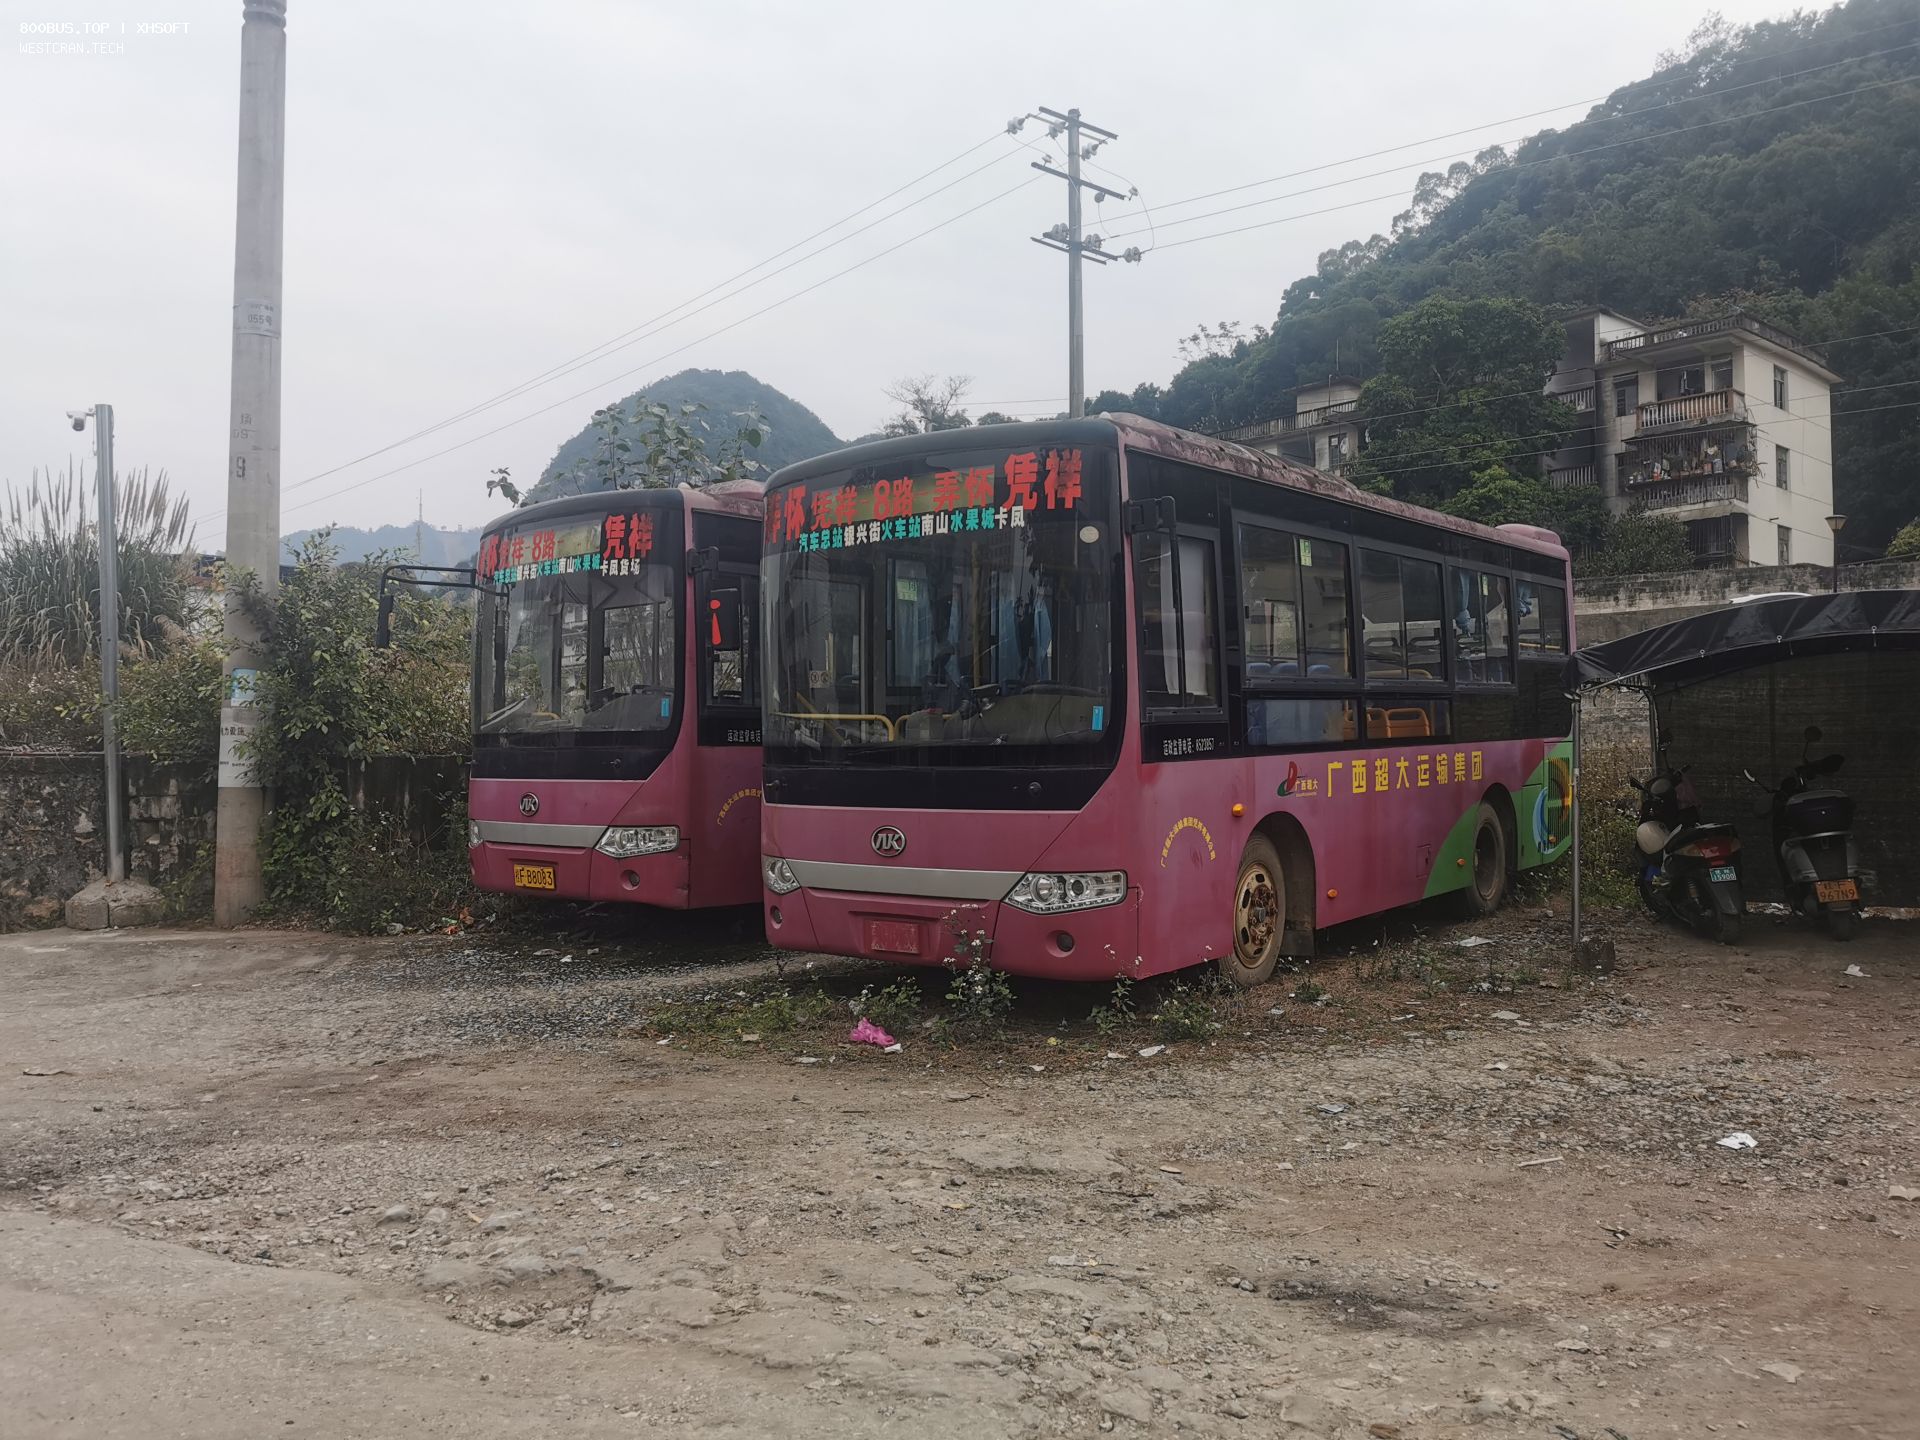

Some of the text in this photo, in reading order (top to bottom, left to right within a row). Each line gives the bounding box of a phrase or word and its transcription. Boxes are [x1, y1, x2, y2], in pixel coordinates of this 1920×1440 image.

[1003, 448, 1083, 510] 凭祥
[602, 511, 655, 559] 凭祥
[1326, 750, 1483, 798] 广西超大运输集团
